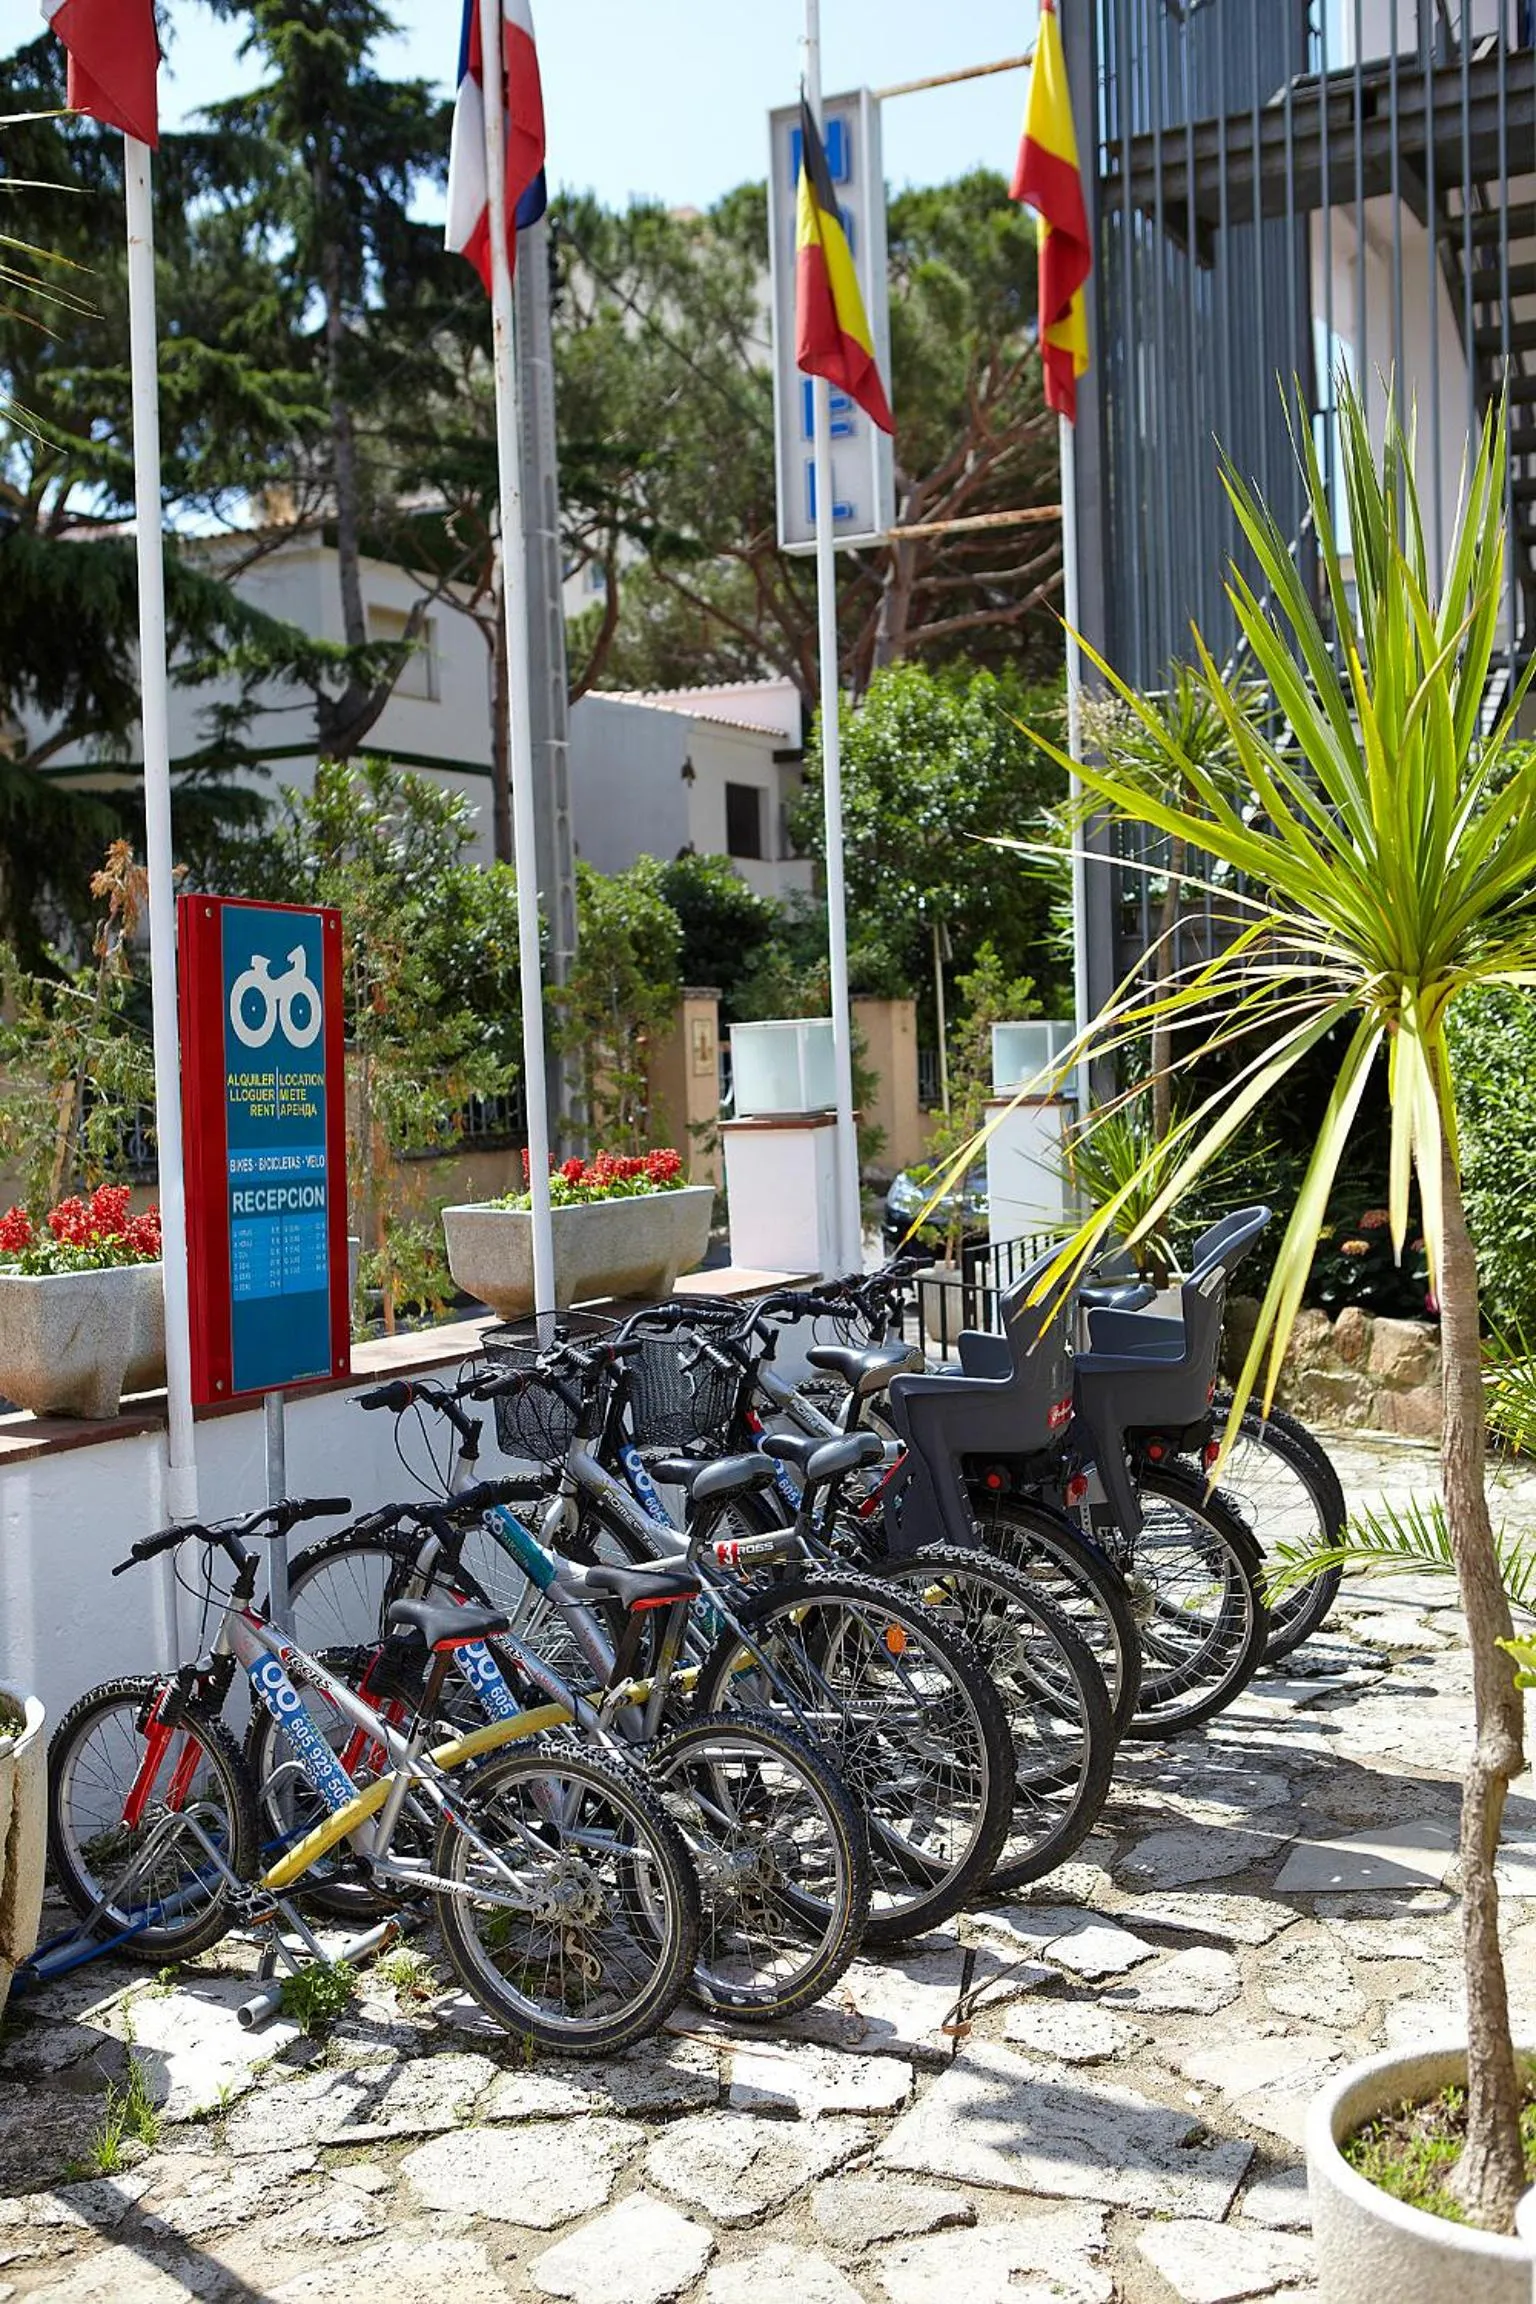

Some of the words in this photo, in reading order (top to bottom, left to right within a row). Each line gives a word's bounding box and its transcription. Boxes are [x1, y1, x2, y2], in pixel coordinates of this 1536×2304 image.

[227, 1073, 275, 1087] ALQUILER
[279, 1073, 325, 1086] LOCATION
[229, 1088, 275, 1102] LLOGUER
[279, 1088, 307, 1101] MIETE
[250, 1103, 275, 1117] RENT
[229, 1158, 253, 1173] BIKES
[258, 1155, 302, 1171] BICICLETAS
[232, 1185, 325, 1213] RECEPCION
[723, 1542, 734, 1565] 3
[490, 1686, 514, 1715] 605
[291, 1718, 315, 1748] 605
[310, 1747, 333, 1777] 929
